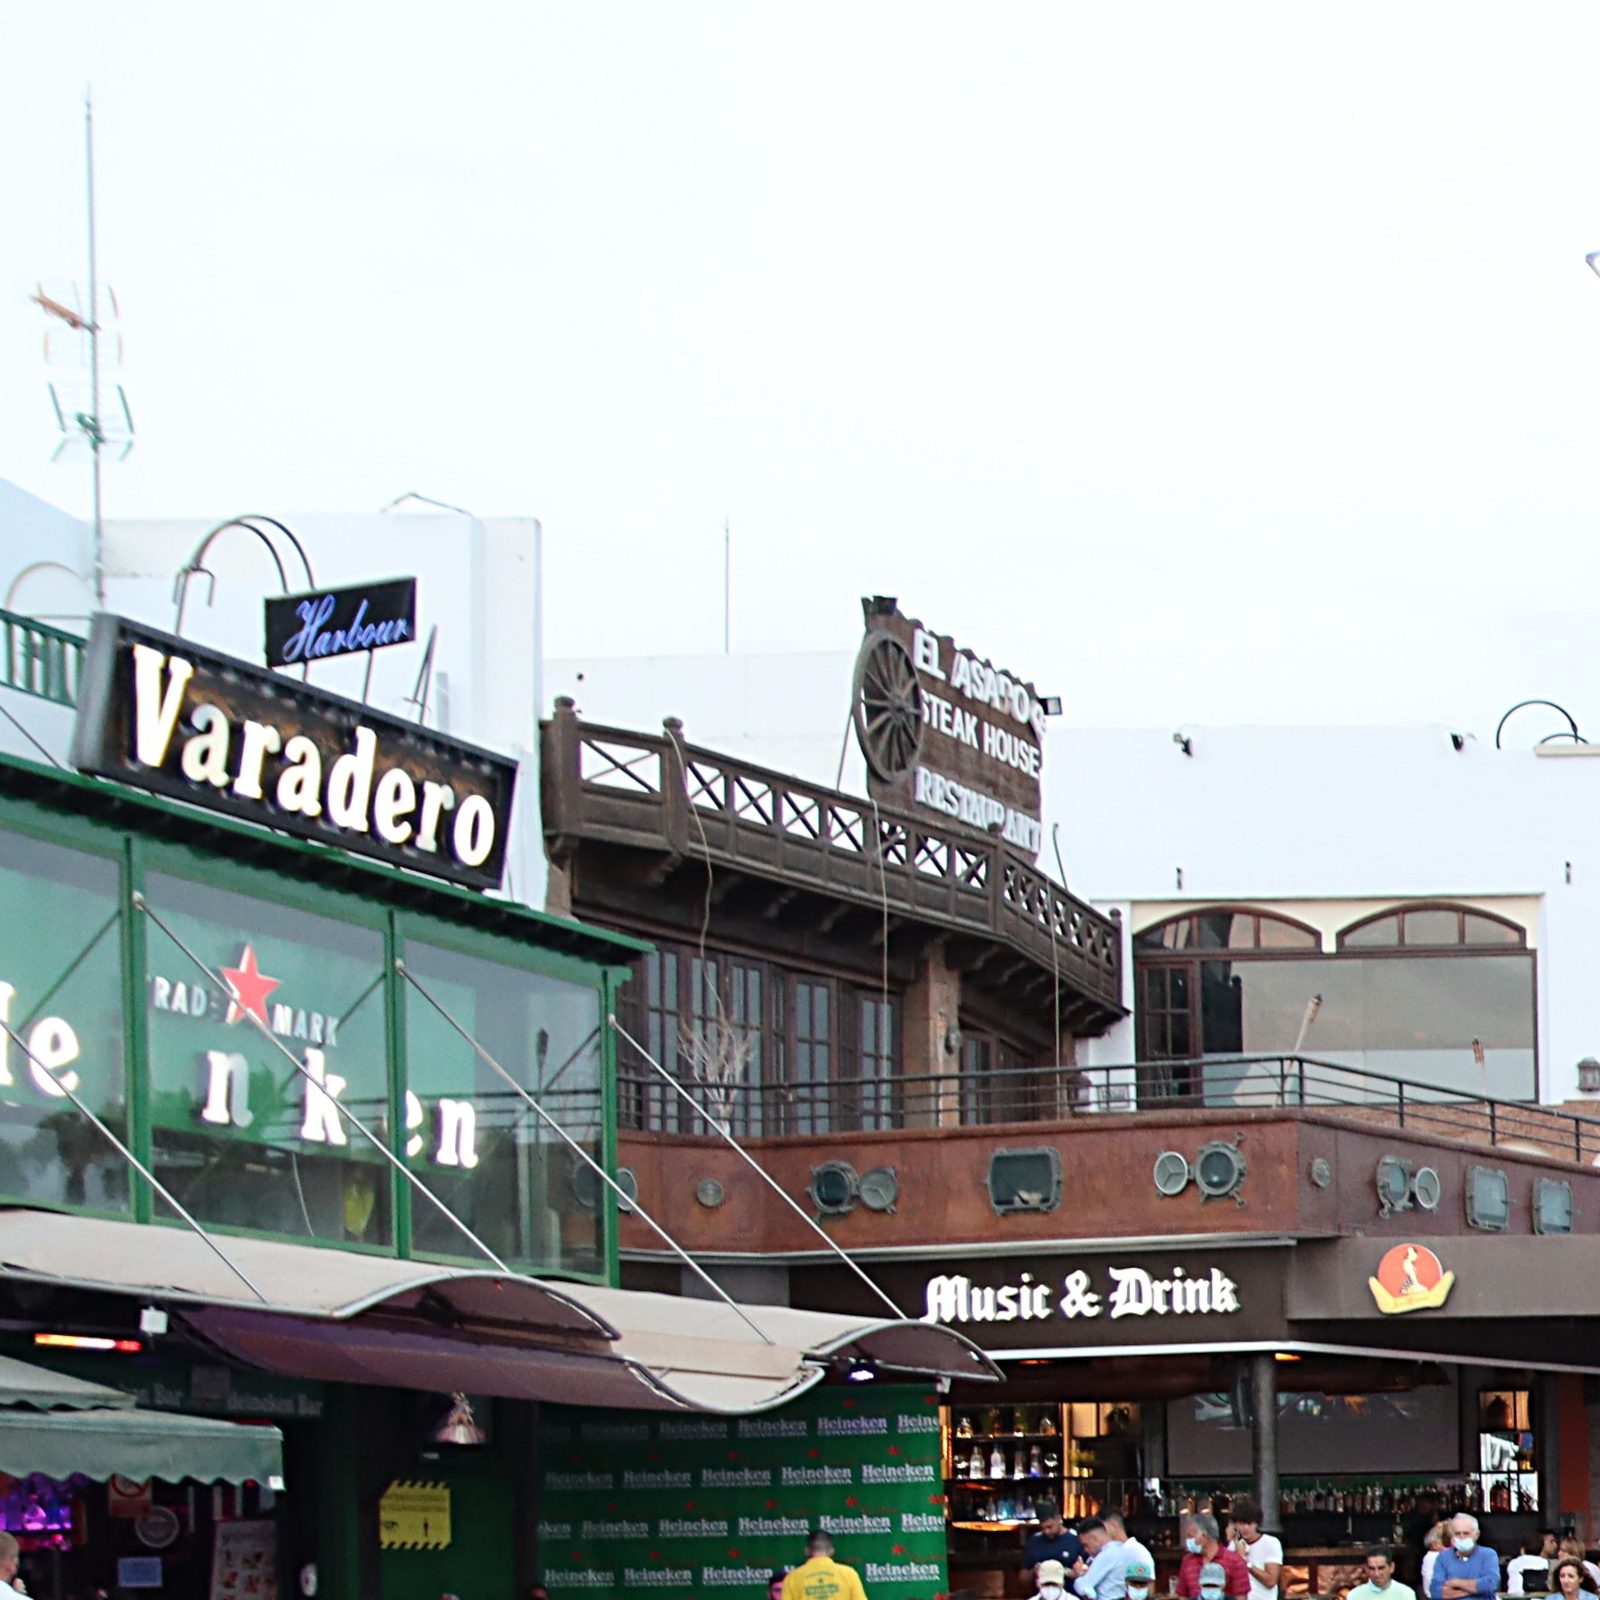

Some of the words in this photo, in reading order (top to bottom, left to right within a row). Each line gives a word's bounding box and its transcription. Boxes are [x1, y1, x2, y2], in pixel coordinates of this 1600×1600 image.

[283, 594, 410, 662] Harbour
[914, 627, 946, 680] EL
[133, 644, 495, 867] Varadero
[983, 724, 1040, 780] HOUSE
[270, 1002, 338, 1046] MARK
[920, 1272, 1051, 1323] Music
[1060, 1270, 1101, 1318] &
[1109, 1267, 1240, 1319] Drink
[738, 1419, 807, 1432] Heineken
[817, 1416, 887, 1430] Heineken
[702, 1468, 771, 1482] Heineken
[782, 1465, 852, 1479] Heineken
[862, 1463, 935, 1477] Heineken
[659, 1518, 728, 1531] Heineken
[738, 1516, 809, 1530] Heineken
[819, 1514, 891, 1529] Heineken
[545, 1568, 615, 1582] Heineken
[623, 1567, 692, 1581] Heineken
[703, 1565, 773, 1579] Heineken
[866, 1562, 940, 1577] Heineken
